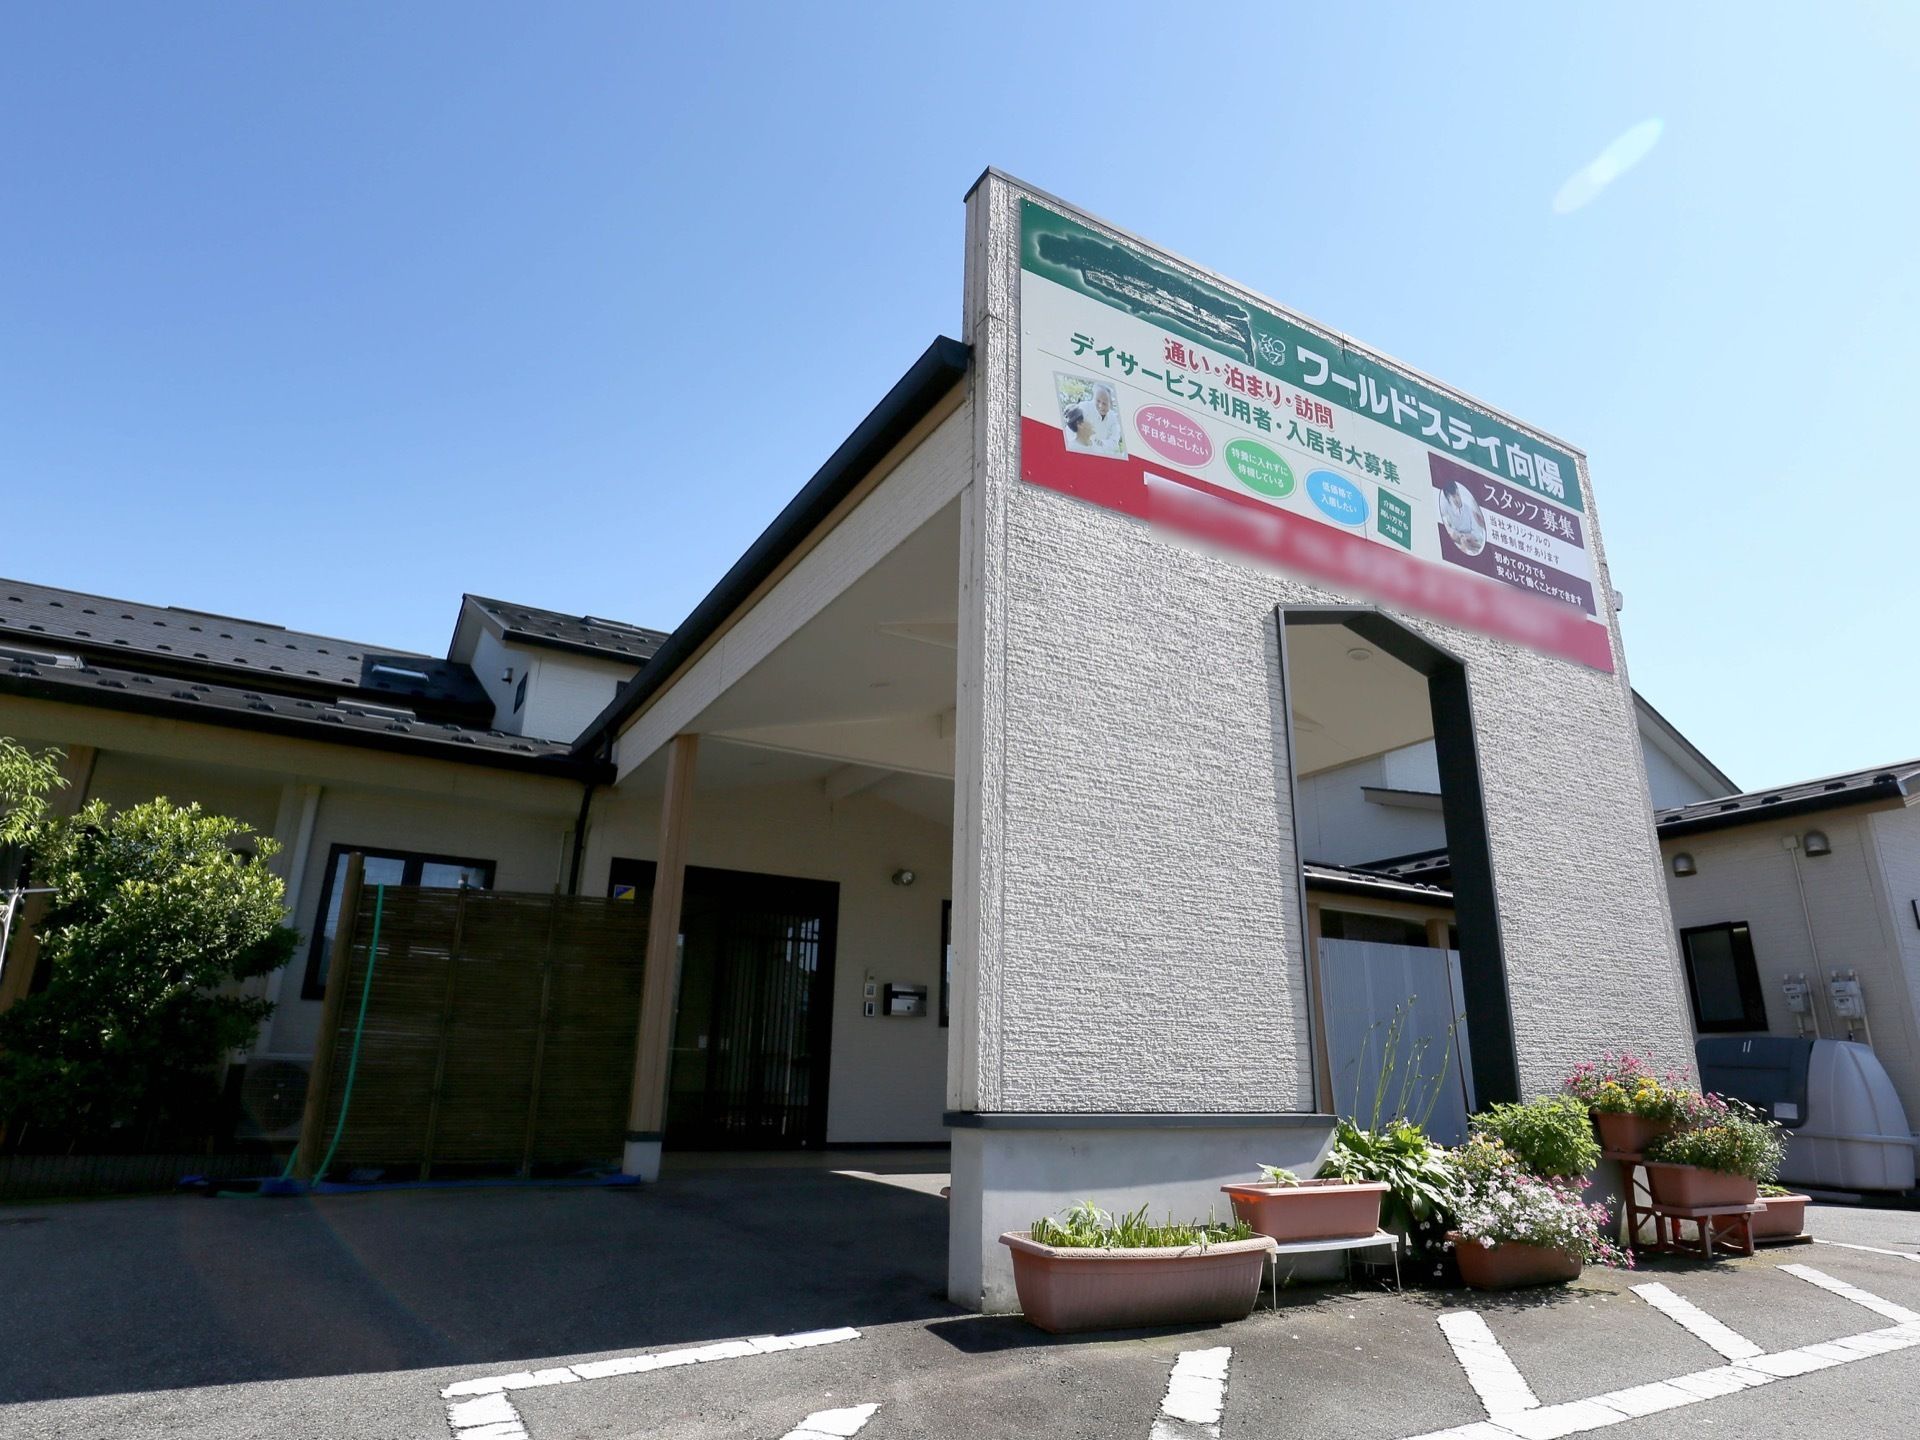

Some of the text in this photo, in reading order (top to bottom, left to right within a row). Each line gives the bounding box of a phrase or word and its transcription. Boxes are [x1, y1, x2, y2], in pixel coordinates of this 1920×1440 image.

[1163, 338, 1334, 430] 通い・泊まり・訪問
[1070, 332, 1400, 485] デイサービス利用者・入居者大募集
[1146, 412, 1203, 441] デイサービスで
[1297, 346, 1565, 498] ワールドステイ向陽
[1141, 424, 1208, 455] 平日を過ごしたい
[1484, 484, 1575, 540] スタッフ募集
[1490, 515, 1551, 548] 当社オリジナルの
[1491, 529, 1559, 565] 研修制度があります
[1494, 551, 1546, 580] 初めての方でも
[1496, 565, 1582, 606] 安心して働くことができます
